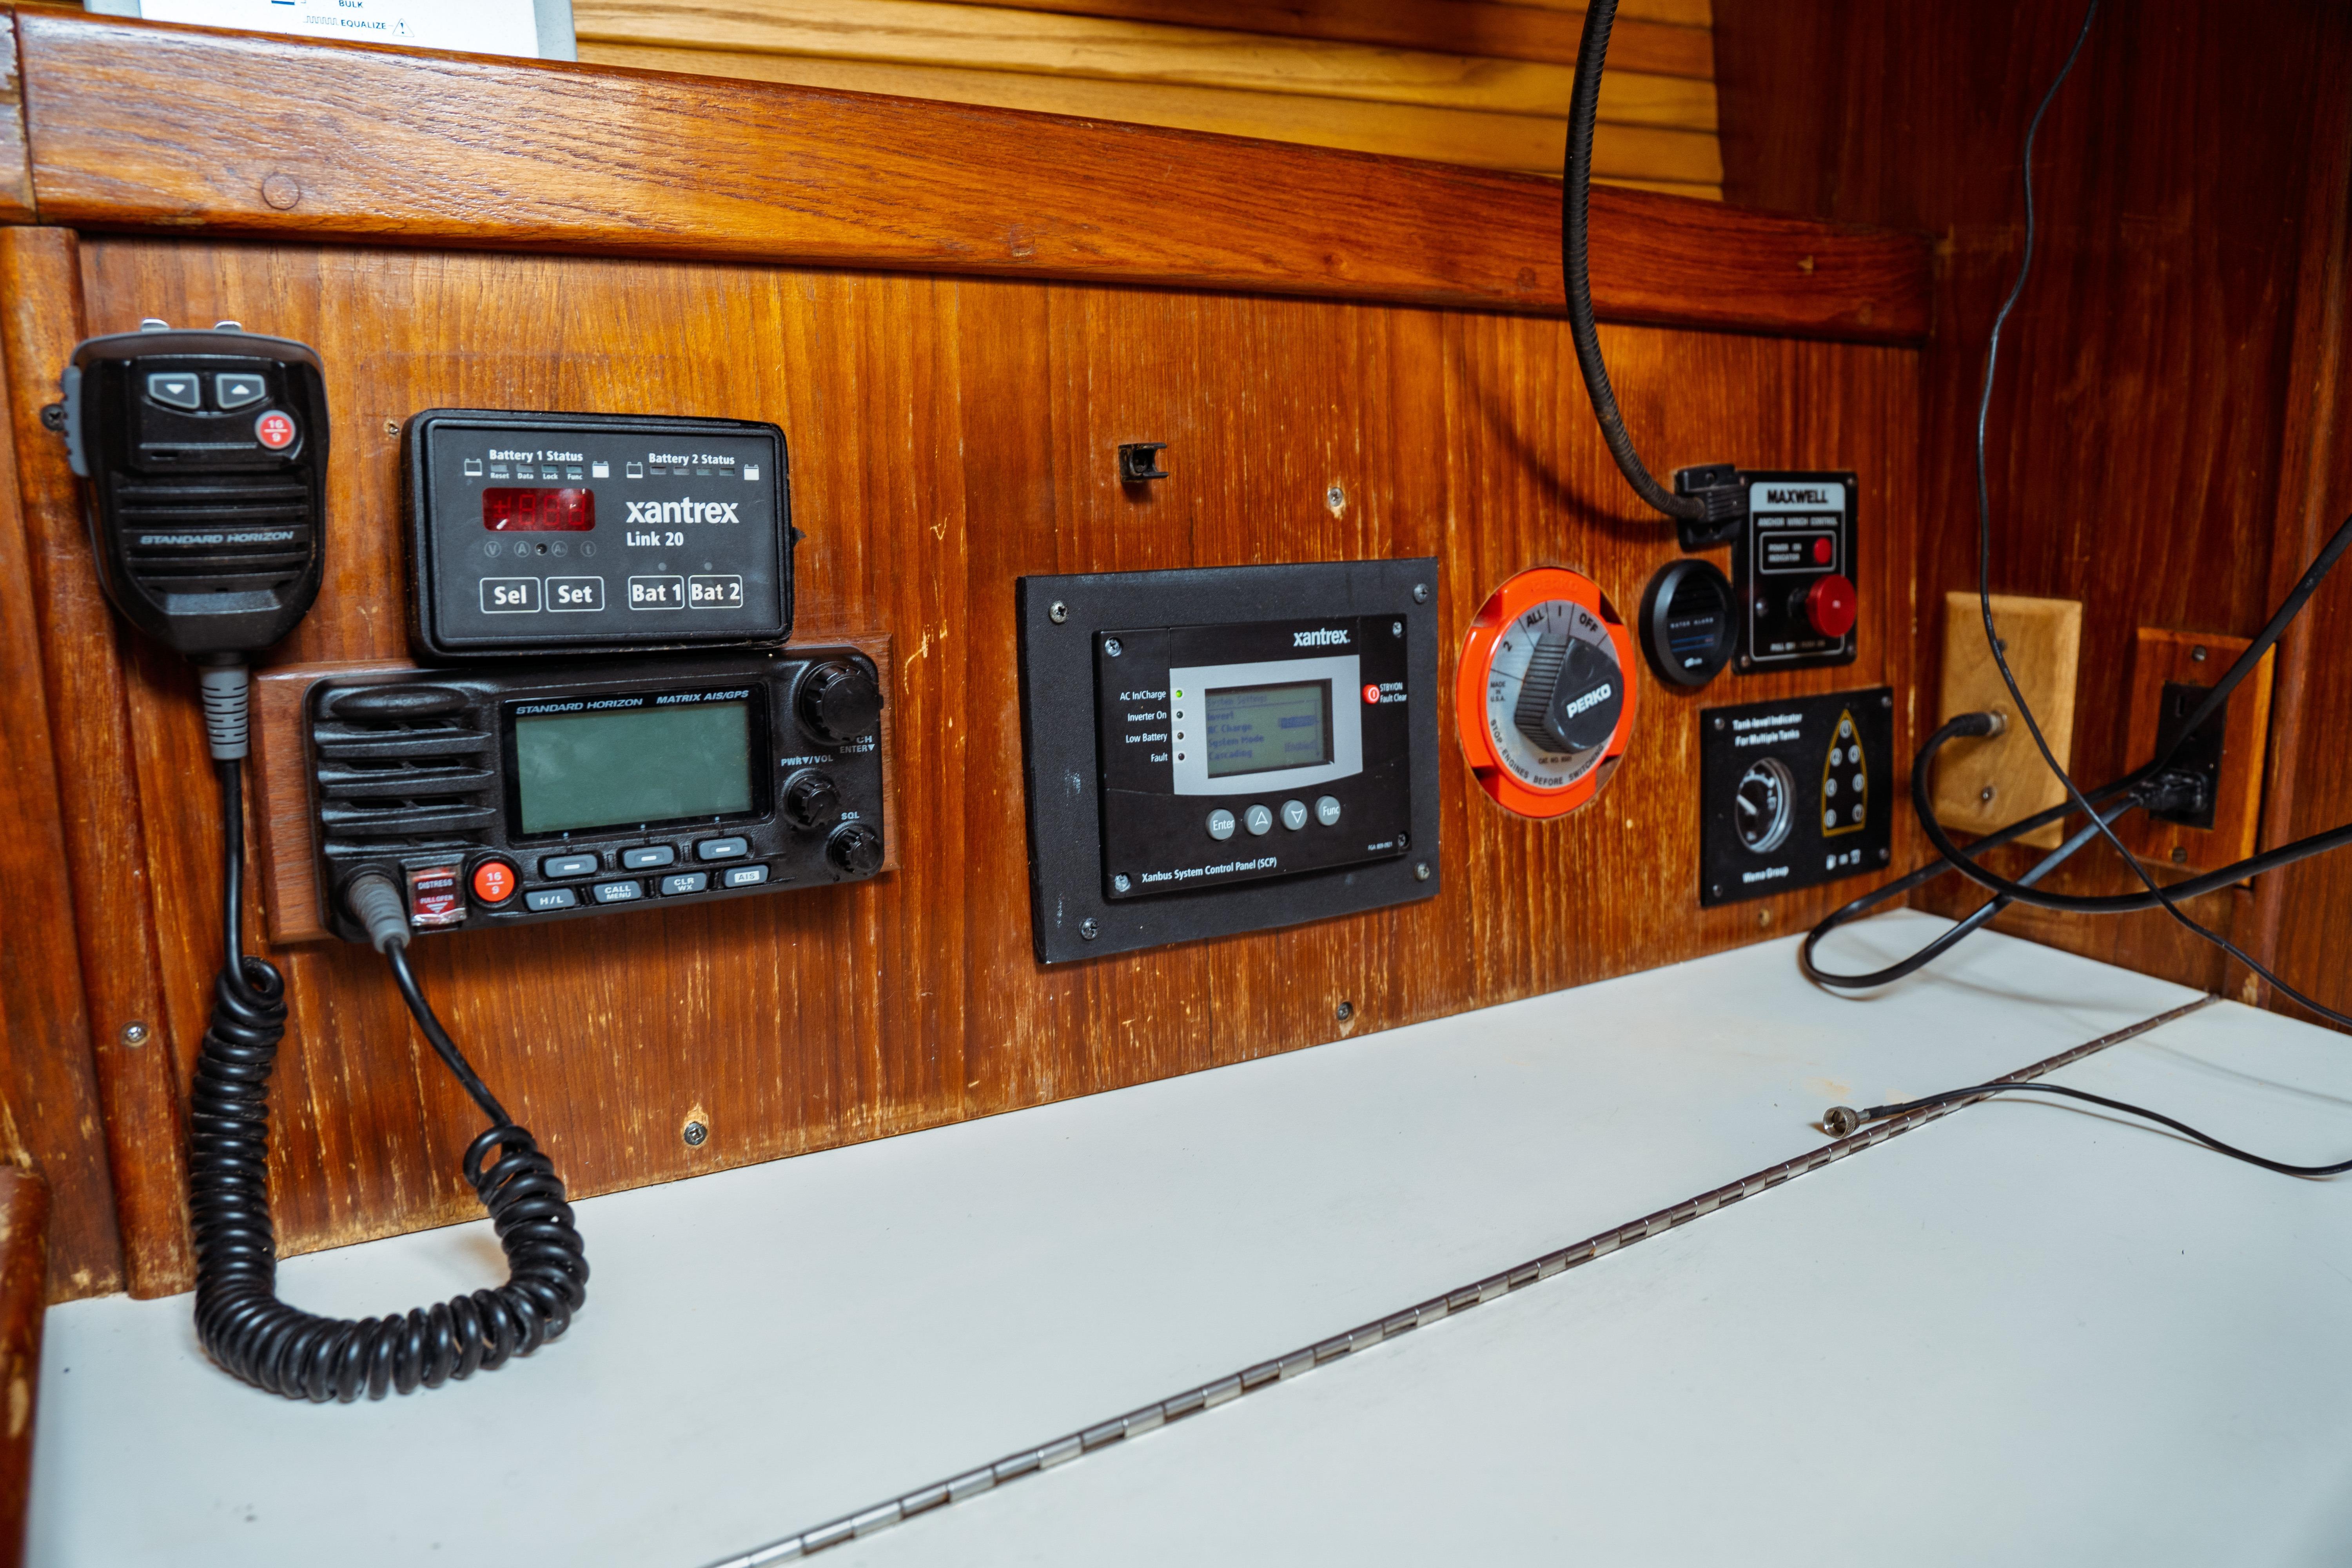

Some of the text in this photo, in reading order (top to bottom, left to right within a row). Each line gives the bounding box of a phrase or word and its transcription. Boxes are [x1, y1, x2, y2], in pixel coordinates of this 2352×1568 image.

[341, 20, 386, 29] EQUALIZE
[269, 419, 283, 429] 16
[272, 432, 281, 442] 9
[489, 449, 583, 463] Battery 1 Status
[649, 453, 735, 466] Battery 2 Status
[1767, 490, 1828, 503] MAXWELL
[626, 497, 739, 524] xantrex
[140, 531, 294, 544] STANDARD HORIZON
[627, 531, 684, 546] Link 20
[494, 585, 527, 604] Sel
[558, 585, 593, 604] Set
[632, 584, 681, 602] Bat 1
[691, 583, 740, 601] Bat 2
[1526, 609, 1545, 627] ALL
[1579, 612, 1599, 632] OFF
[1294, 628, 1348, 646] xantrex
[1503, 641, 1512, 652] 2
[657, 690, 749, 704] MATRIX AIS/GPS
[1120, 690, 1167, 701] AC In/Charge
[1380, 693, 1407, 704] Fault Clear
[1566, 683, 1612, 719] PERKO
[516, 698, 642, 715] STANDARD HORIZON
[1128, 711, 1167, 722] Inverter On
[1125, 733, 1167, 743] Low Battery
[840, 745, 867, 754] ENTER
[1490, 719, 1503, 744] STOP
[1502, 748, 1529, 779] ENGINES
[1534, 775, 1564, 785] BEFORE
[1151, 752, 1168, 762] Fault
[841, 811, 860, 820] SQL
[1323, 806, 1339, 816] Func
[1213, 819, 1234, 831] Enter
[1142, 857, 1277, 883] Xanbus System Control Panel (SCP)
[486, 872, 501, 881] 16
[674, 877, 695, 886] CLR
[739, 872, 755, 881] AIS
[417, 878, 453, 889] DISTRESS
[492, 886, 500, 894] 9
[604, 885, 631, 894] CALL
[539, 895, 564, 906] H/L
[606, 892, 632, 900] MENU
